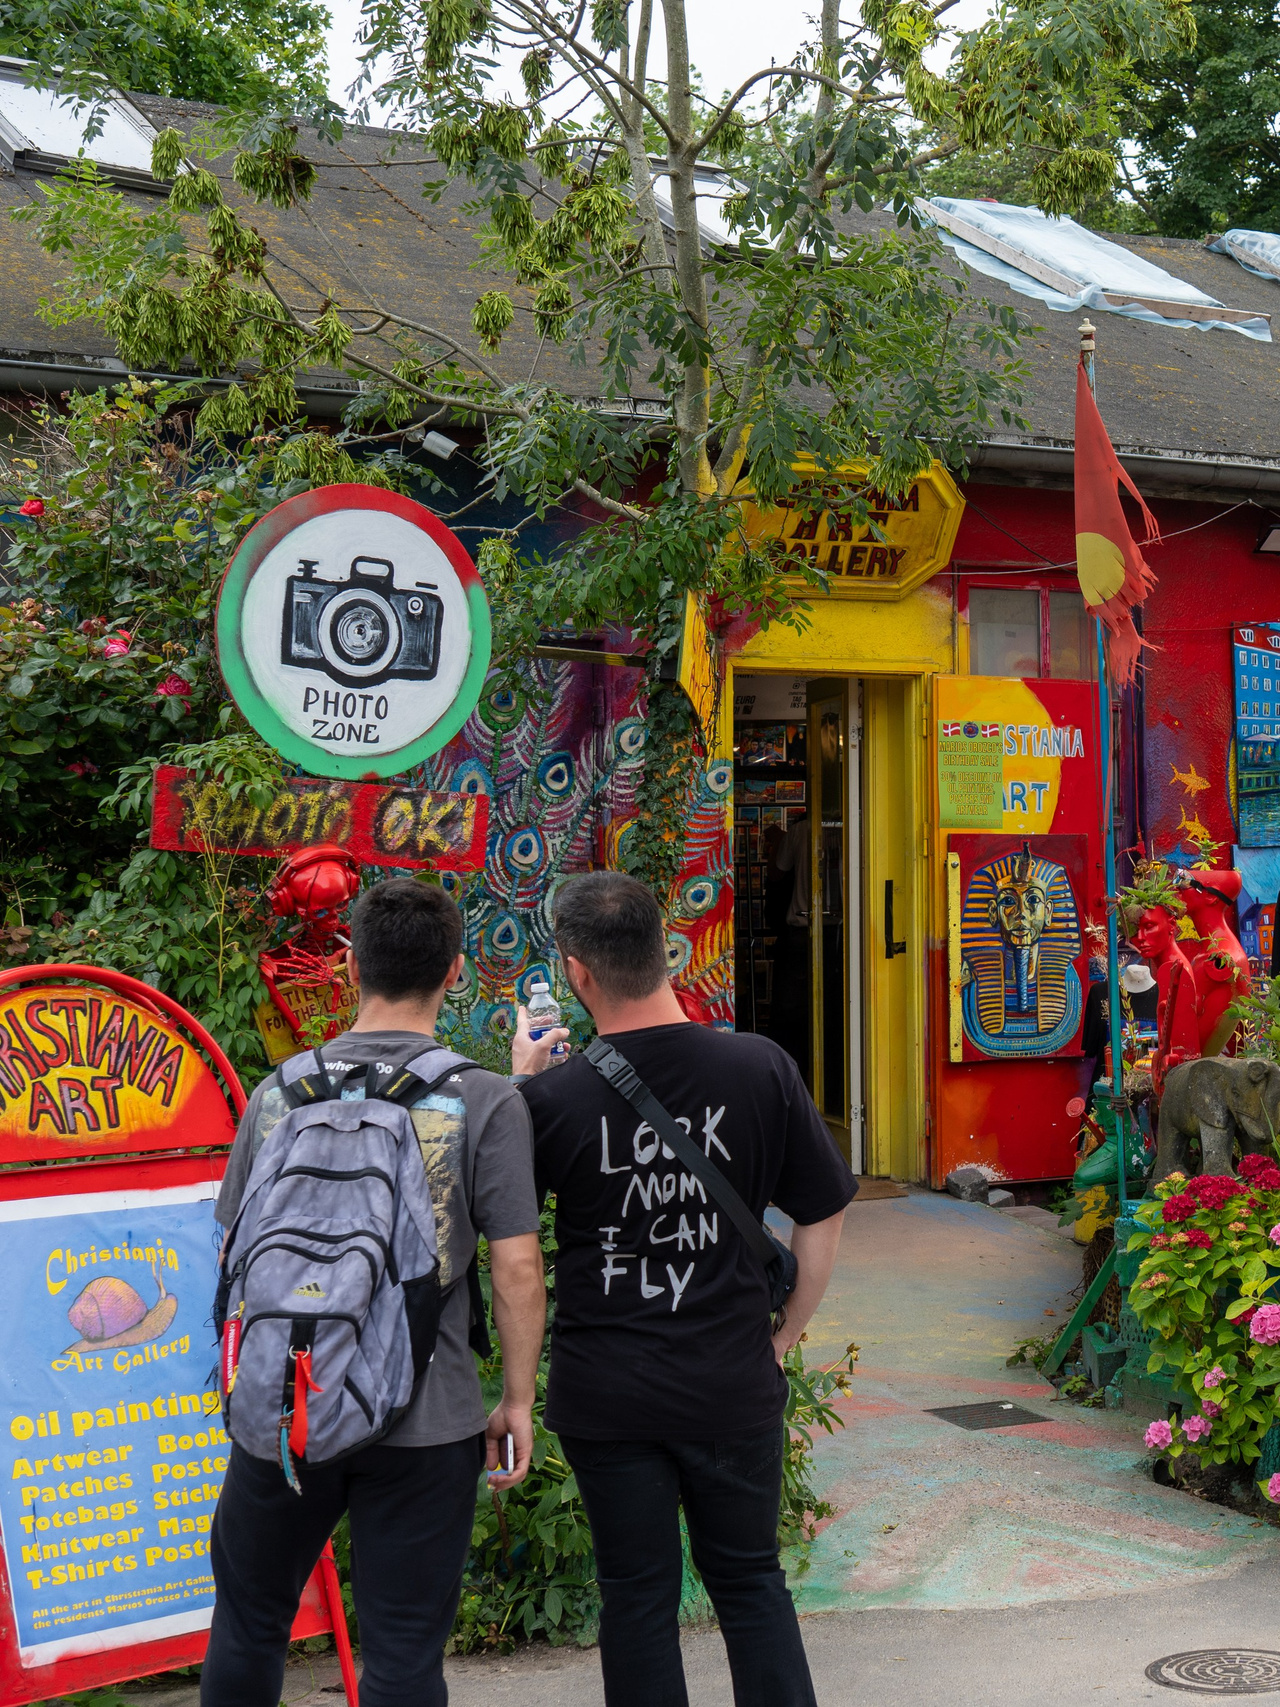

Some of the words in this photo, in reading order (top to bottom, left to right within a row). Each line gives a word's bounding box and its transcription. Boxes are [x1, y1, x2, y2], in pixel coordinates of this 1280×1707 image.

[790, 511, 889, 543] ART
[303, 686, 389, 720] PHOTO
[735, 695, 756, 705] EURO
[311, 718, 380, 744] ZONE
[939, 741, 967, 753] MARIOS
[968, 741, 1003, 754] OROZCO'S
[940, 771, 957, 783] 30%
[958, 772, 991, 782] DISCOUNT
[992, 771, 1002, 783] ON
[943, 754, 979, 766] BIRTHDAY
[980, 755, 999, 767] SALE
[947, 783, 958, 793] OIL
[949, 794, 978, 805] POSTERS
[979, 794, 994, 805] AND
[955, 805, 989, 816] ARTWEAR
[28, 1076, 124, 1135] ART
[621, 1171, 707, 1218] MOM
[598, 1226, 622, 1252] I
[649, 1211, 718, 1252] CAN
[45, 1238, 180, 1296] Christiania
[600, 1253, 696, 1313] FLY
[51, 1350, 104, 1373] Art
[113, 1334, 191, 1375] Gallery
[10, 1410, 61, 1441] Oil
[72, 1390, 223, 1437] painting
[11, 1444, 134, 1480] Artwear
[21, 1472, 134, 1507] Patches
[151, 1455, 231, 1484] Poste
[20, 1499, 139, 1534] Totebags
[21, 1526, 145, 1564] Knitwear
[158, 1513, 215, 1538] Mag
[26, 1554, 138, 1590] T-Shirts
[32, 1609, 48, 1619] All
[51, 1605, 70, 1615] the
[72, 1601, 89, 1611] art
[91, 1597, 102, 1606] in
[104, 1585, 163, 1604] Christiania
[164, 1581, 183, 1591] Art
[33, 1620, 52, 1630] the
[54, 1609, 105, 1626] residents
[107, 1600, 143, 1615] Marios
[145, 1593, 181, 1606] Orozco
[183, 1590, 191, 1598] &
